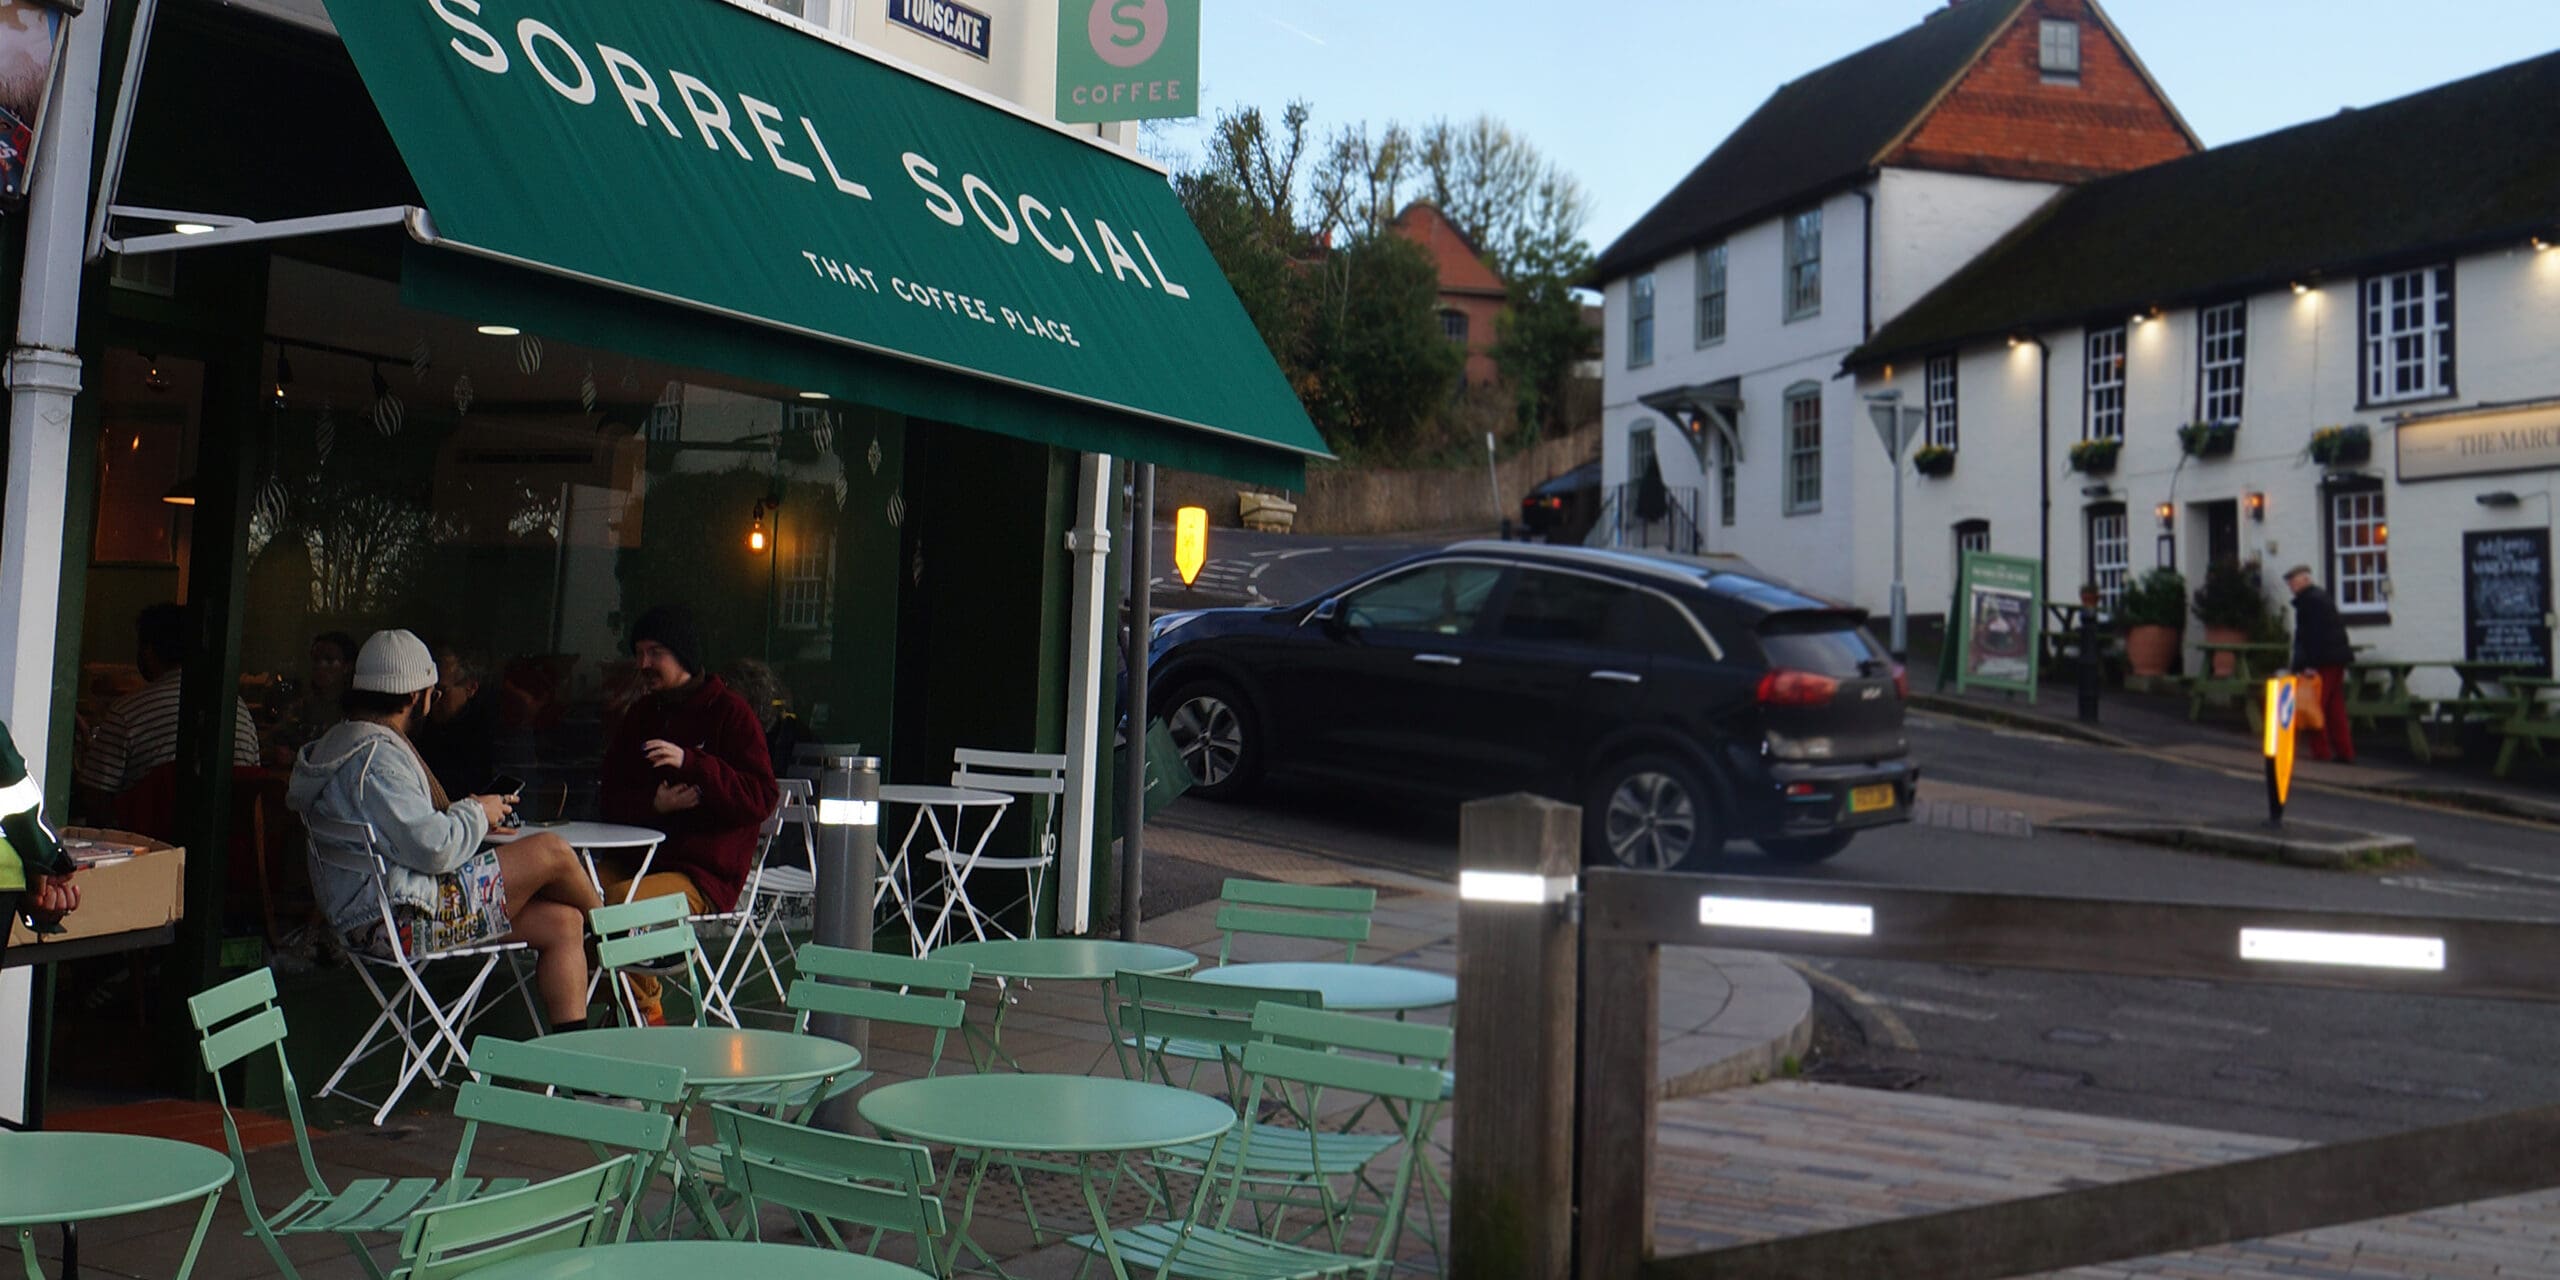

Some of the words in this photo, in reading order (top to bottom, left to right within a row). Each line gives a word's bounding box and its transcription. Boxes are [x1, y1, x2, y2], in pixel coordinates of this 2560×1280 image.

[1109, 0, 1146, 48] S
[1072, 80, 1181, 106] COFFEE
[428, 0, 873, 200] SORREL
[902, 151, 1190, 300] SOCIAL
[802, 250, 880, 294] THAT
[891, 277, 996, 324] COFFEE
[1000, 306, 1081, 348] PLACE
[2457, 430, 2496, 457] THE
